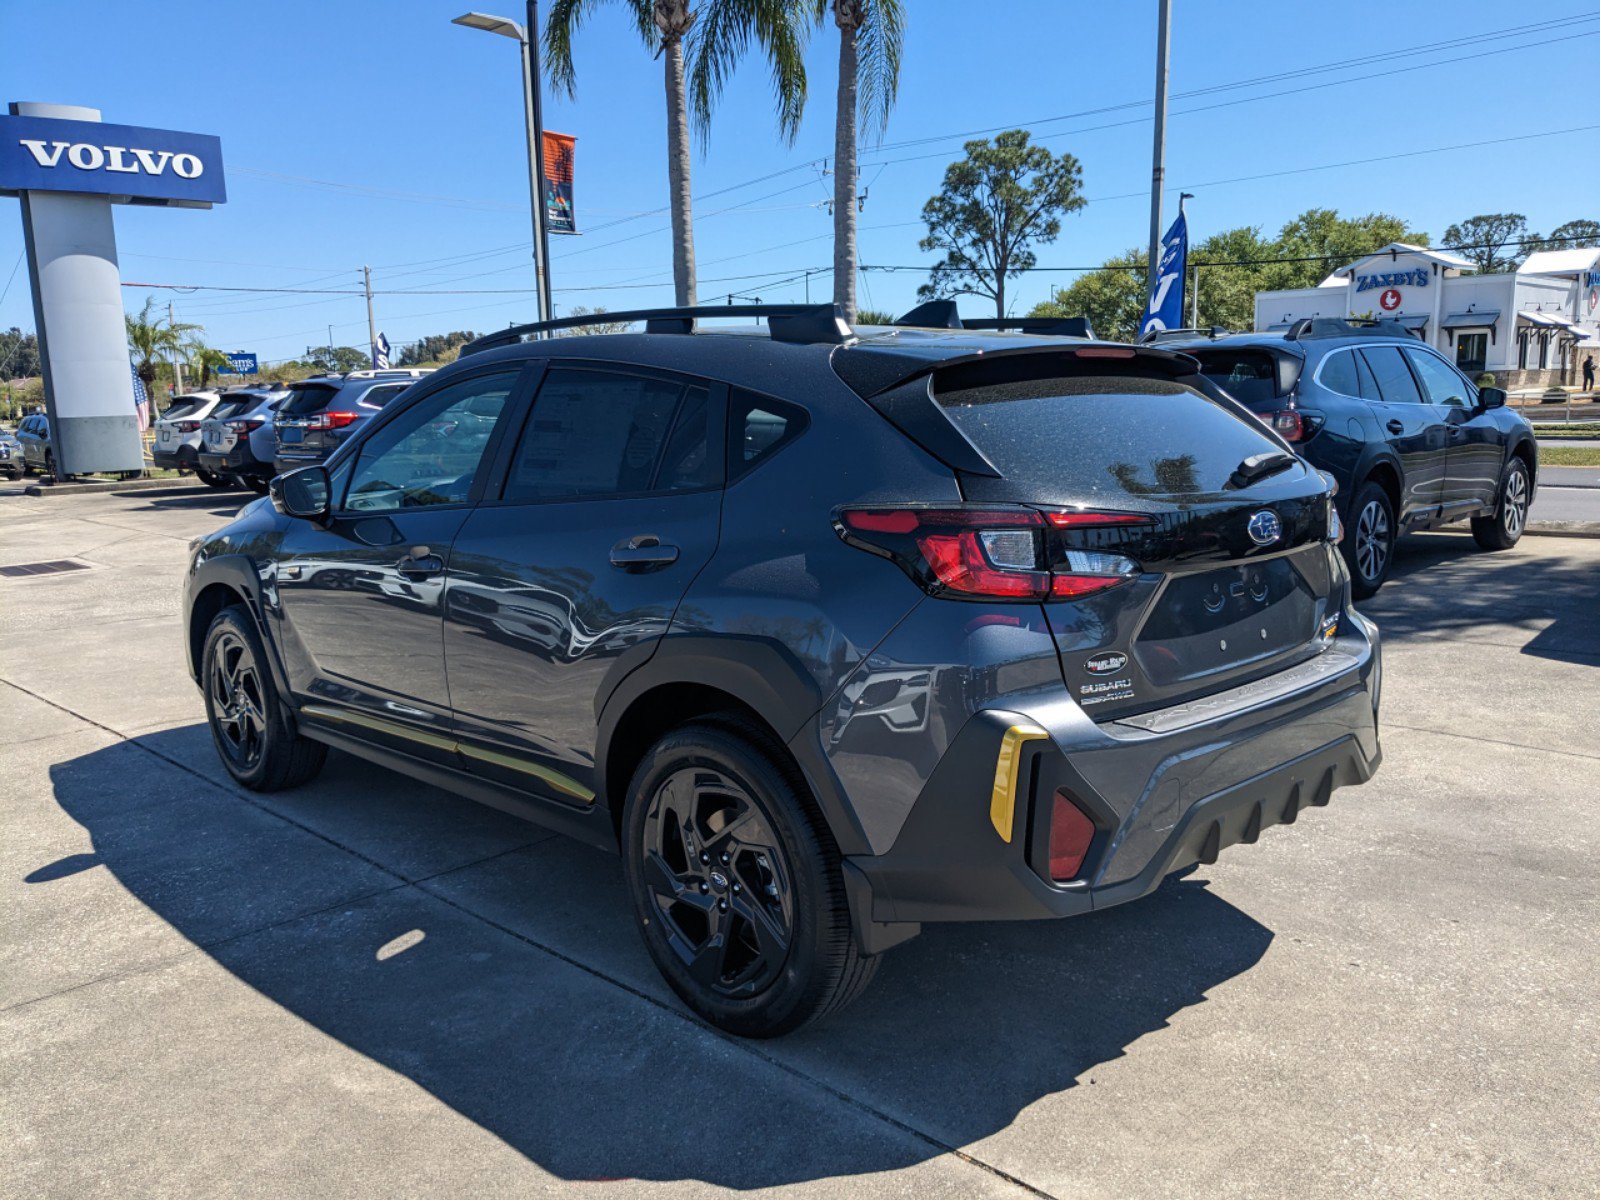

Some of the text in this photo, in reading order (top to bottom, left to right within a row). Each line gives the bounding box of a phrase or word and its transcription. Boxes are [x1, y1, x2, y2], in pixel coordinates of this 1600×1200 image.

[19, 139, 204, 179] VOLVO
[1356, 268, 1428, 293] ZAXBY'S
[1080, 678, 1131, 694] SUBARU
